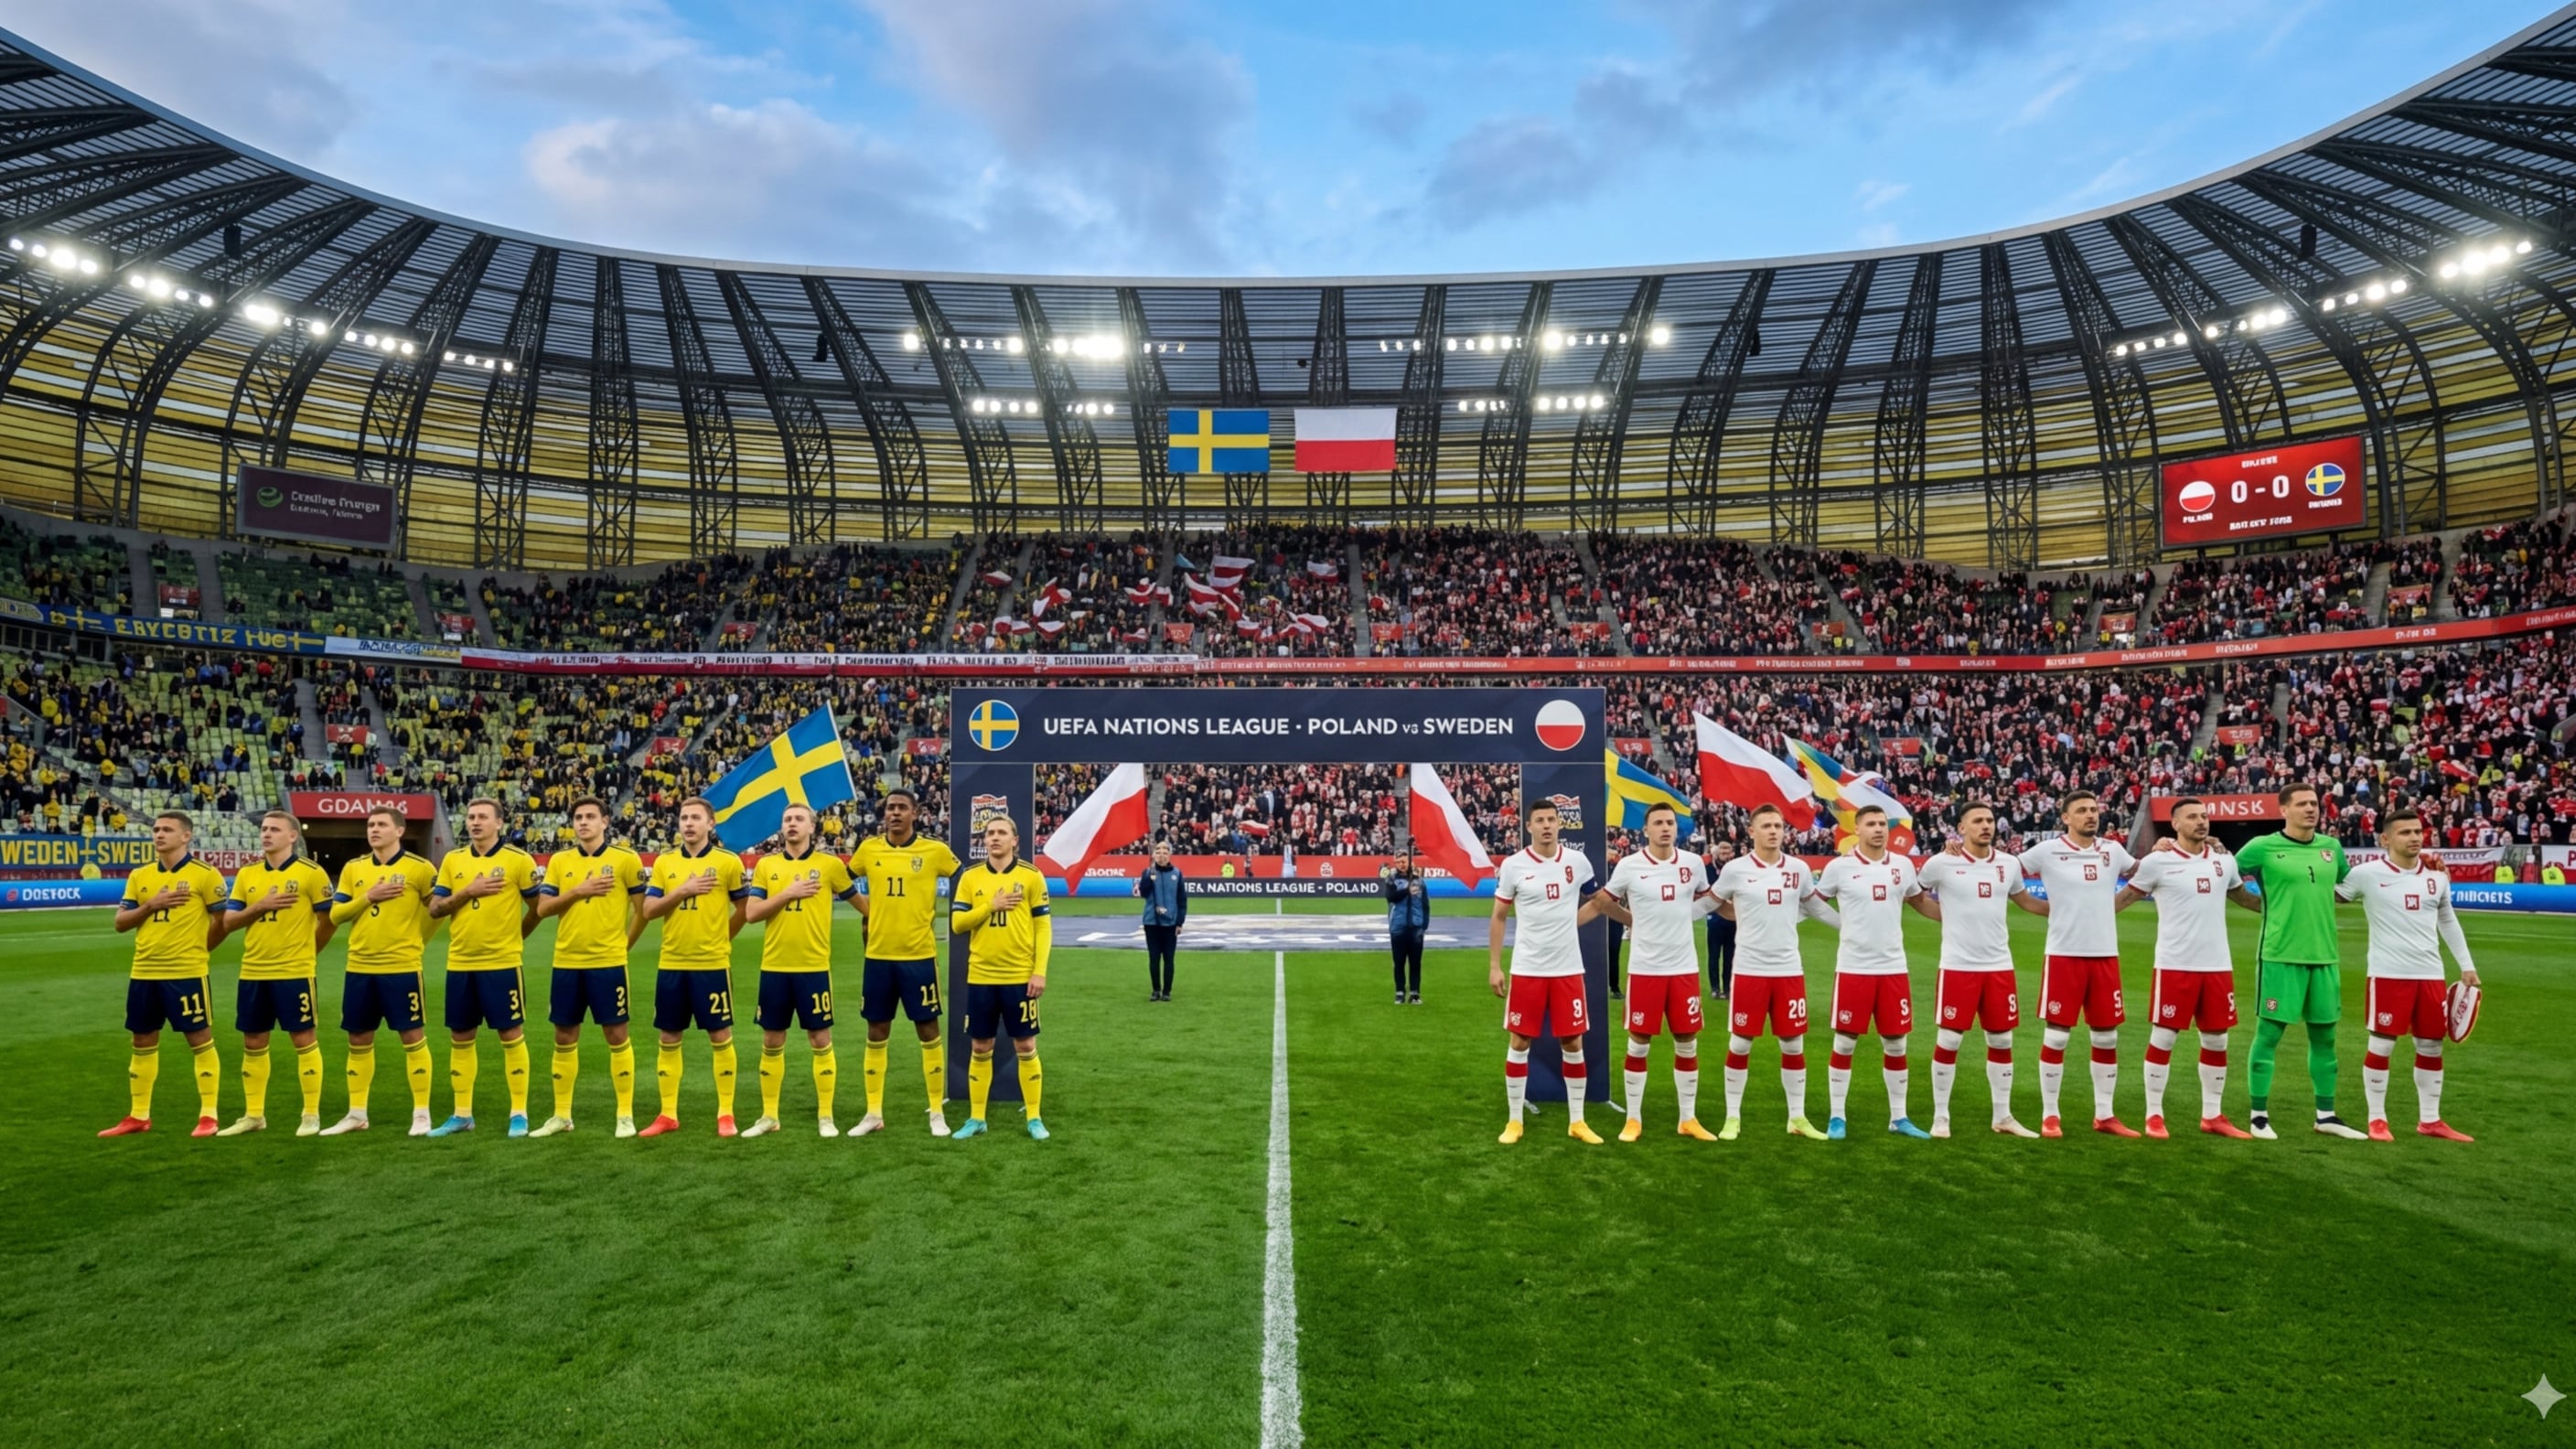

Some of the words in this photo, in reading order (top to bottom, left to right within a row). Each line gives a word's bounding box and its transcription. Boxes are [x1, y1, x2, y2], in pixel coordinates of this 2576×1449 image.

[2231, 480, 2248, 503] 0
[2272, 475, 2290, 498] 0
[1044, 718, 1098, 735] UEFA
[1103, 718, 1199, 735] NATIONS
[1206, 718, 1289, 735] LEAGUE
[1308, 718, 1397, 735] POLAND
[1423, 718, 1514, 735] SWEDEN
[97, 841, 159, 864] SWED
[886, 877, 906, 896] 11
[1326, 883, 1379, 893] POLAND
[180, 993, 204, 1016] 11
[299, 993, 310, 1013] 3
[408, 992, 419, 1012] 3
[509, 990, 519, 1010] 3
[709, 991, 730, 1014] 21
